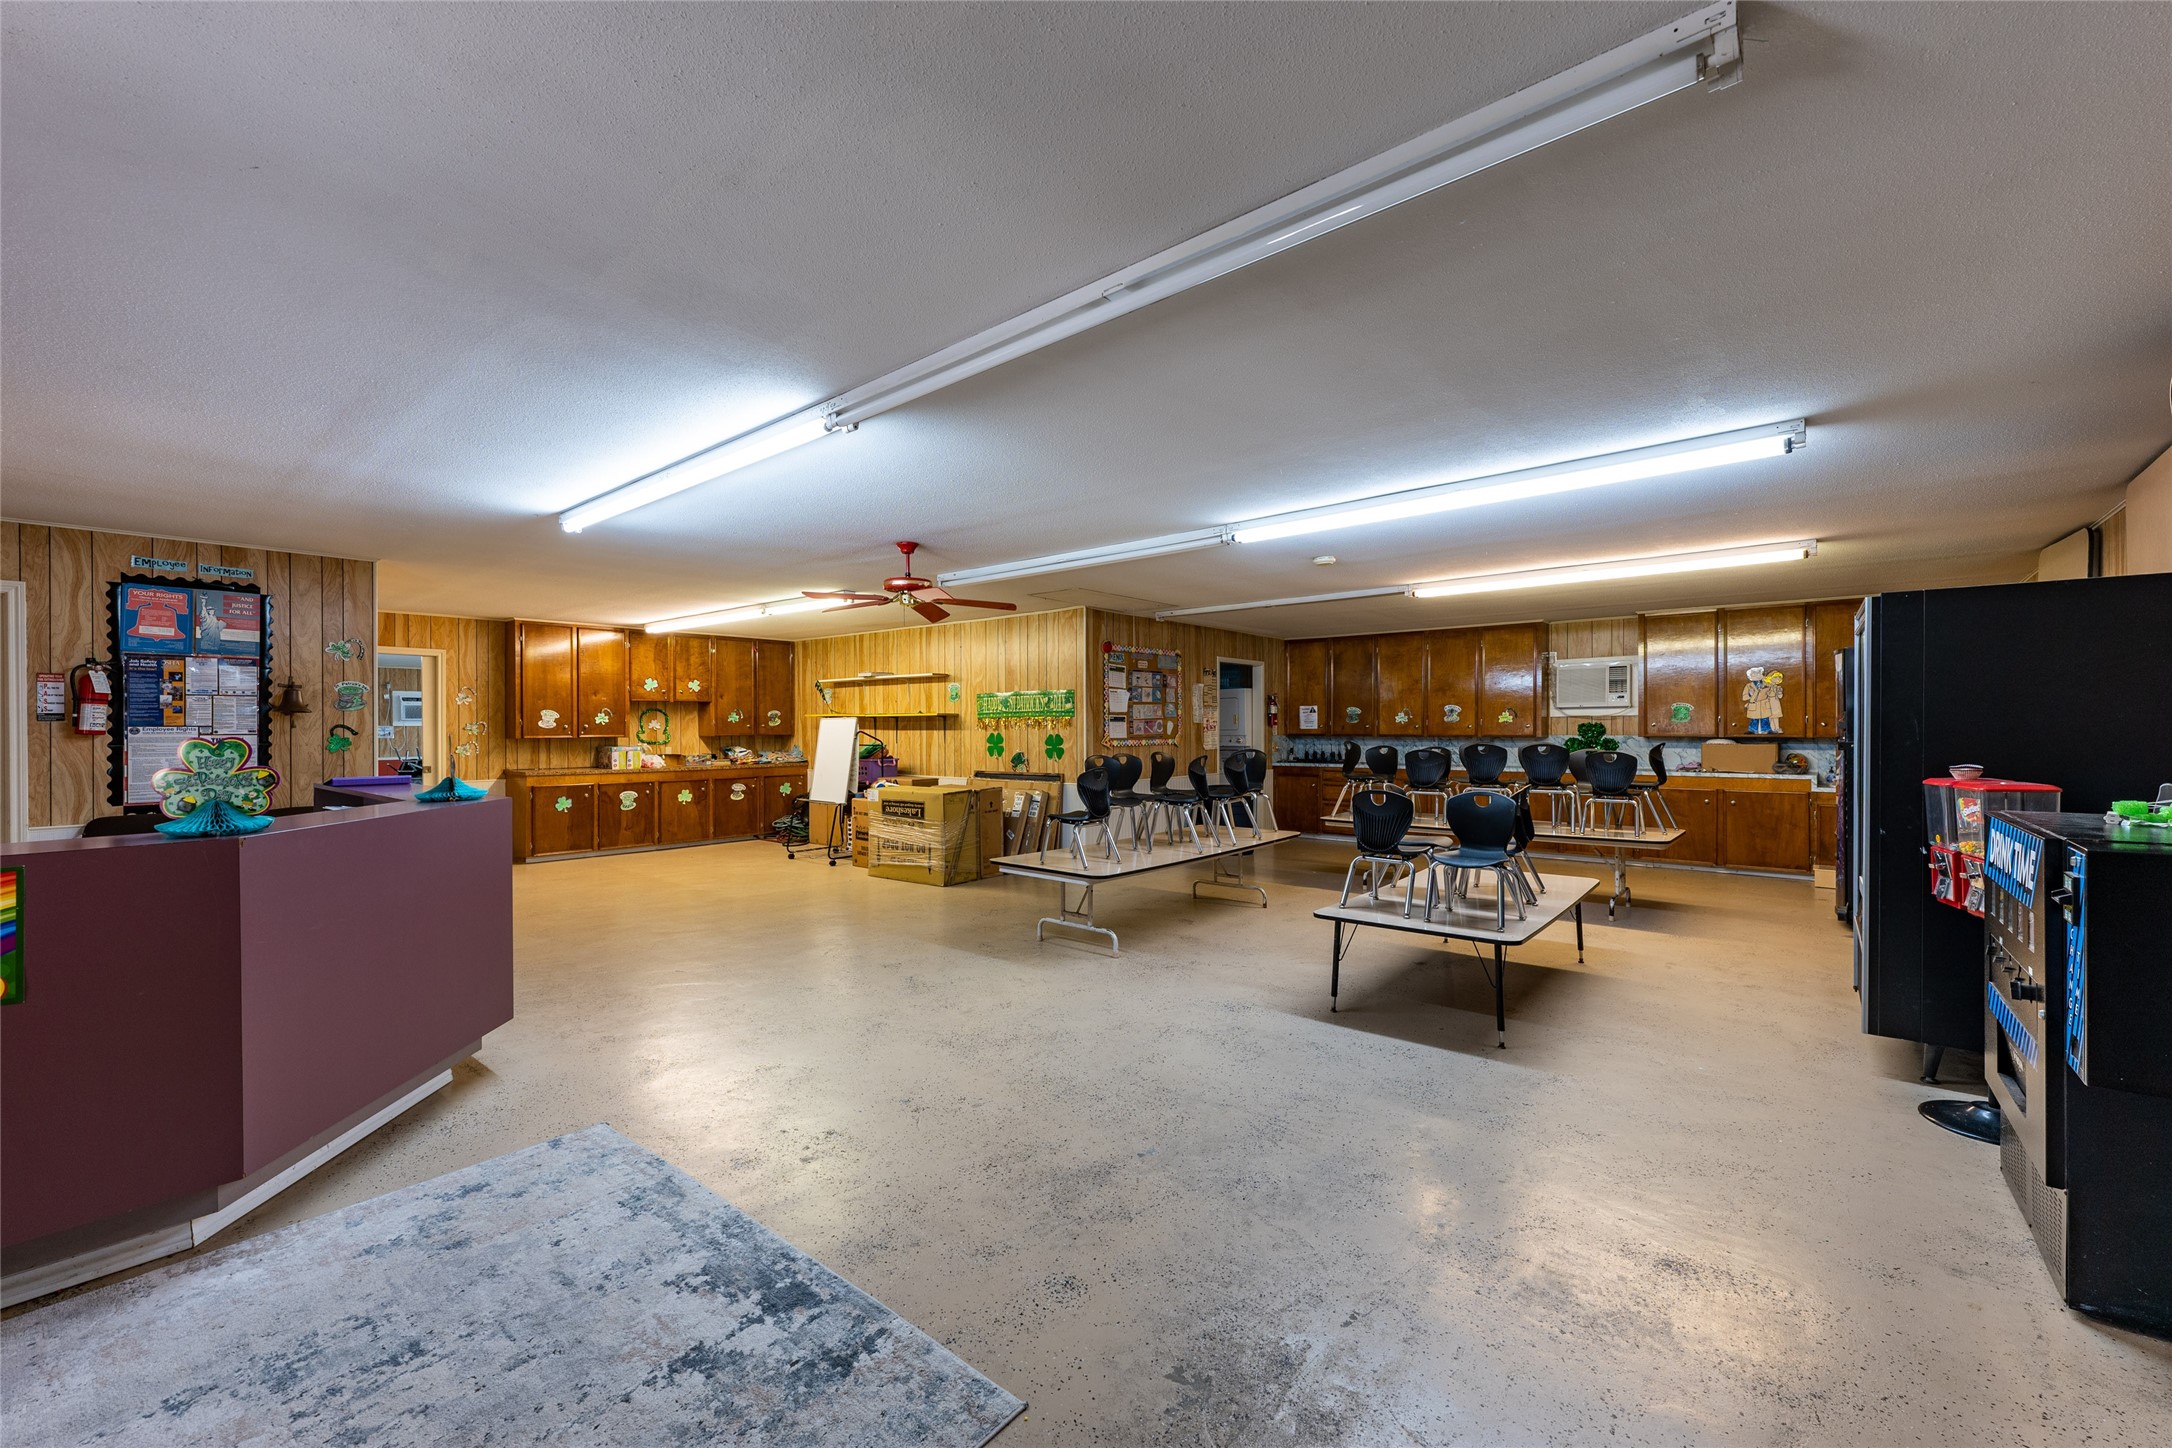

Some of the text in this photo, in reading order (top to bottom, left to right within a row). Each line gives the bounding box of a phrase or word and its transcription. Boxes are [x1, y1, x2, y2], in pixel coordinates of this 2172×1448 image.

[195, 755, 236, 771] Happy
[201, 788, 235, 801] Day
[885, 806, 921, 818] Lakeshore
[1989, 828, 2037, 891] DRINK TIME
